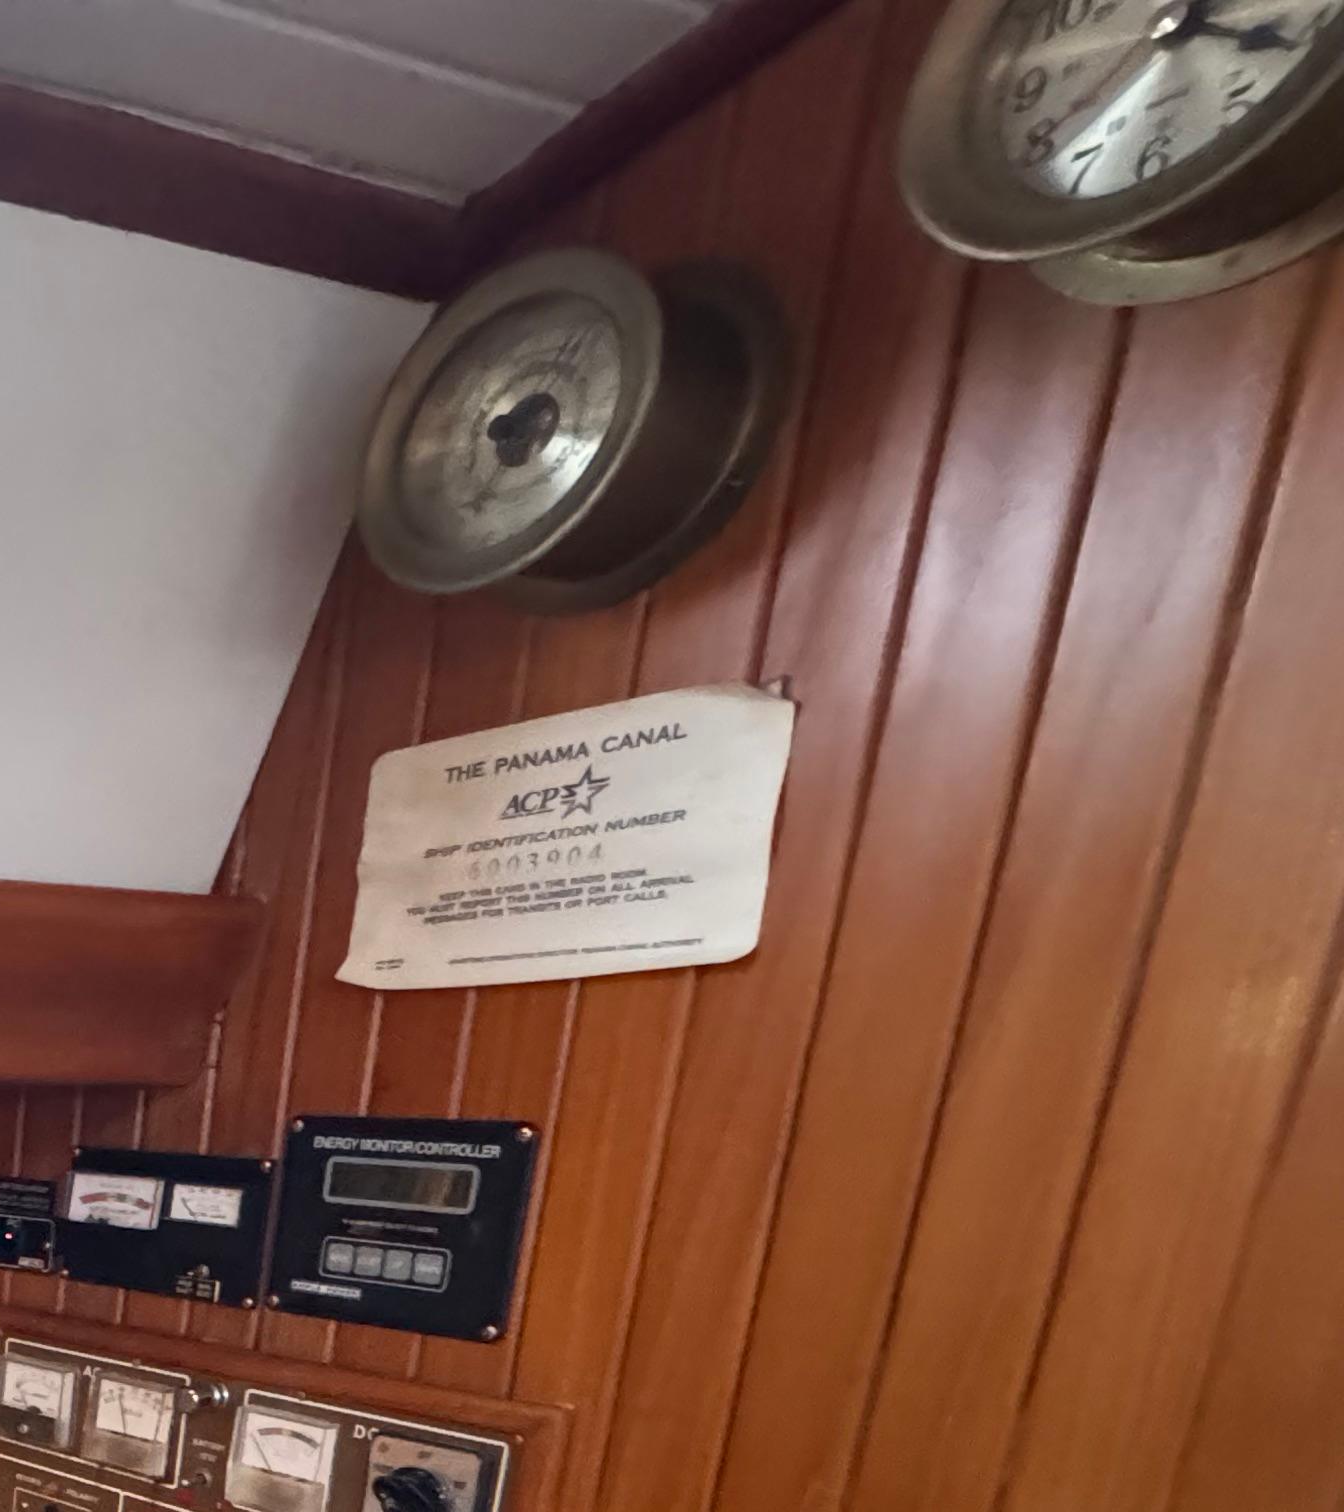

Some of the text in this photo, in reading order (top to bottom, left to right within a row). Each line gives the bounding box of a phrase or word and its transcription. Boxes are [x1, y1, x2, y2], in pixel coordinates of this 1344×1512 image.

[1013, 66, 1048, 113] 9
[1070, 142, 1105, 196] 7
[1135, 134, 1171, 182] 6
[445, 722, 688, 784] THE PANAMA CANAL
[501, 786, 561, 818] ACP
[466, 823, 599, 853] IDENTIFICATION
[604, 809, 687, 833] NUMBER
[313, 1135, 360, 1151] ENERGY
